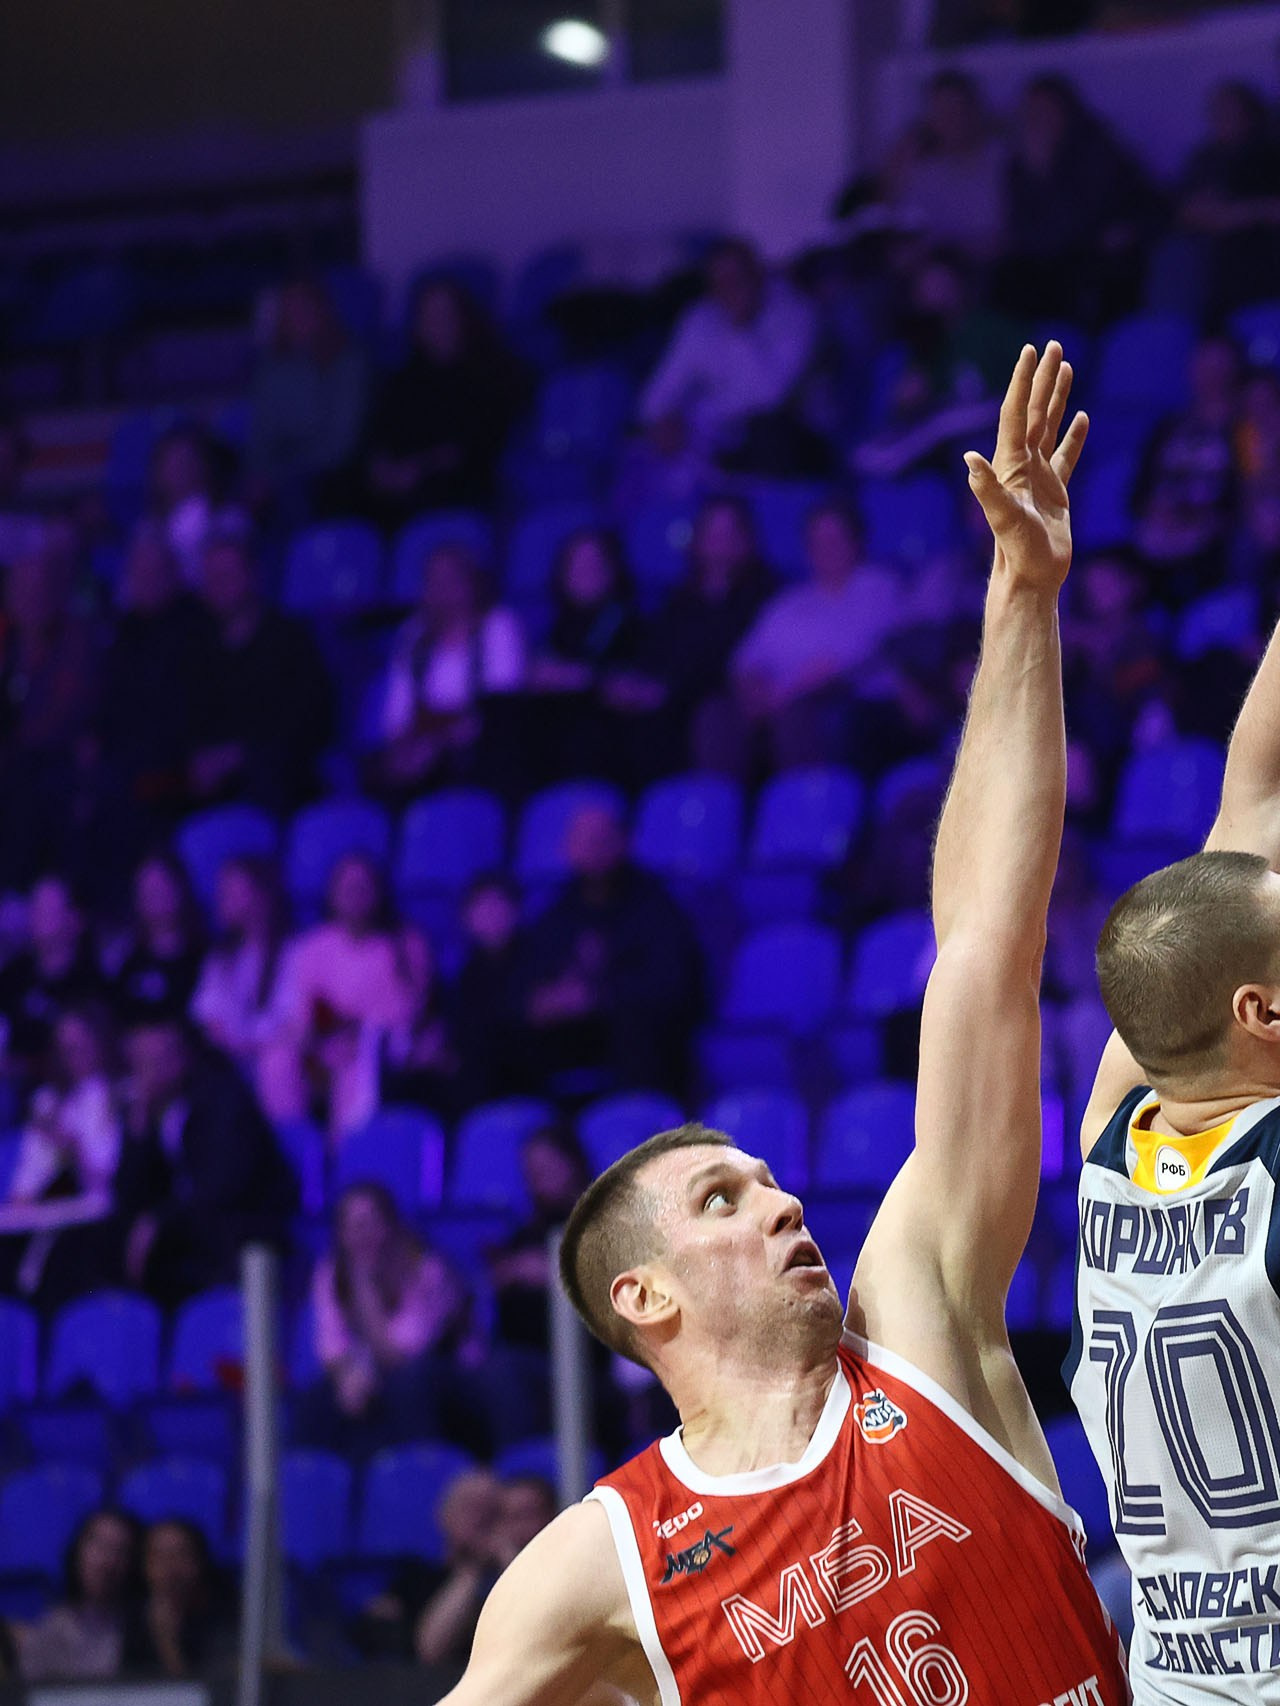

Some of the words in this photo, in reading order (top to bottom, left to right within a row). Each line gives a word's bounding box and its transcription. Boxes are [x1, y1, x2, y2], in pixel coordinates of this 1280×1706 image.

[1161, 1161, 1187, 1177] РФБ
[721, 1488, 972, 1665] МБА
[844, 1609, 969, 1706] 16
